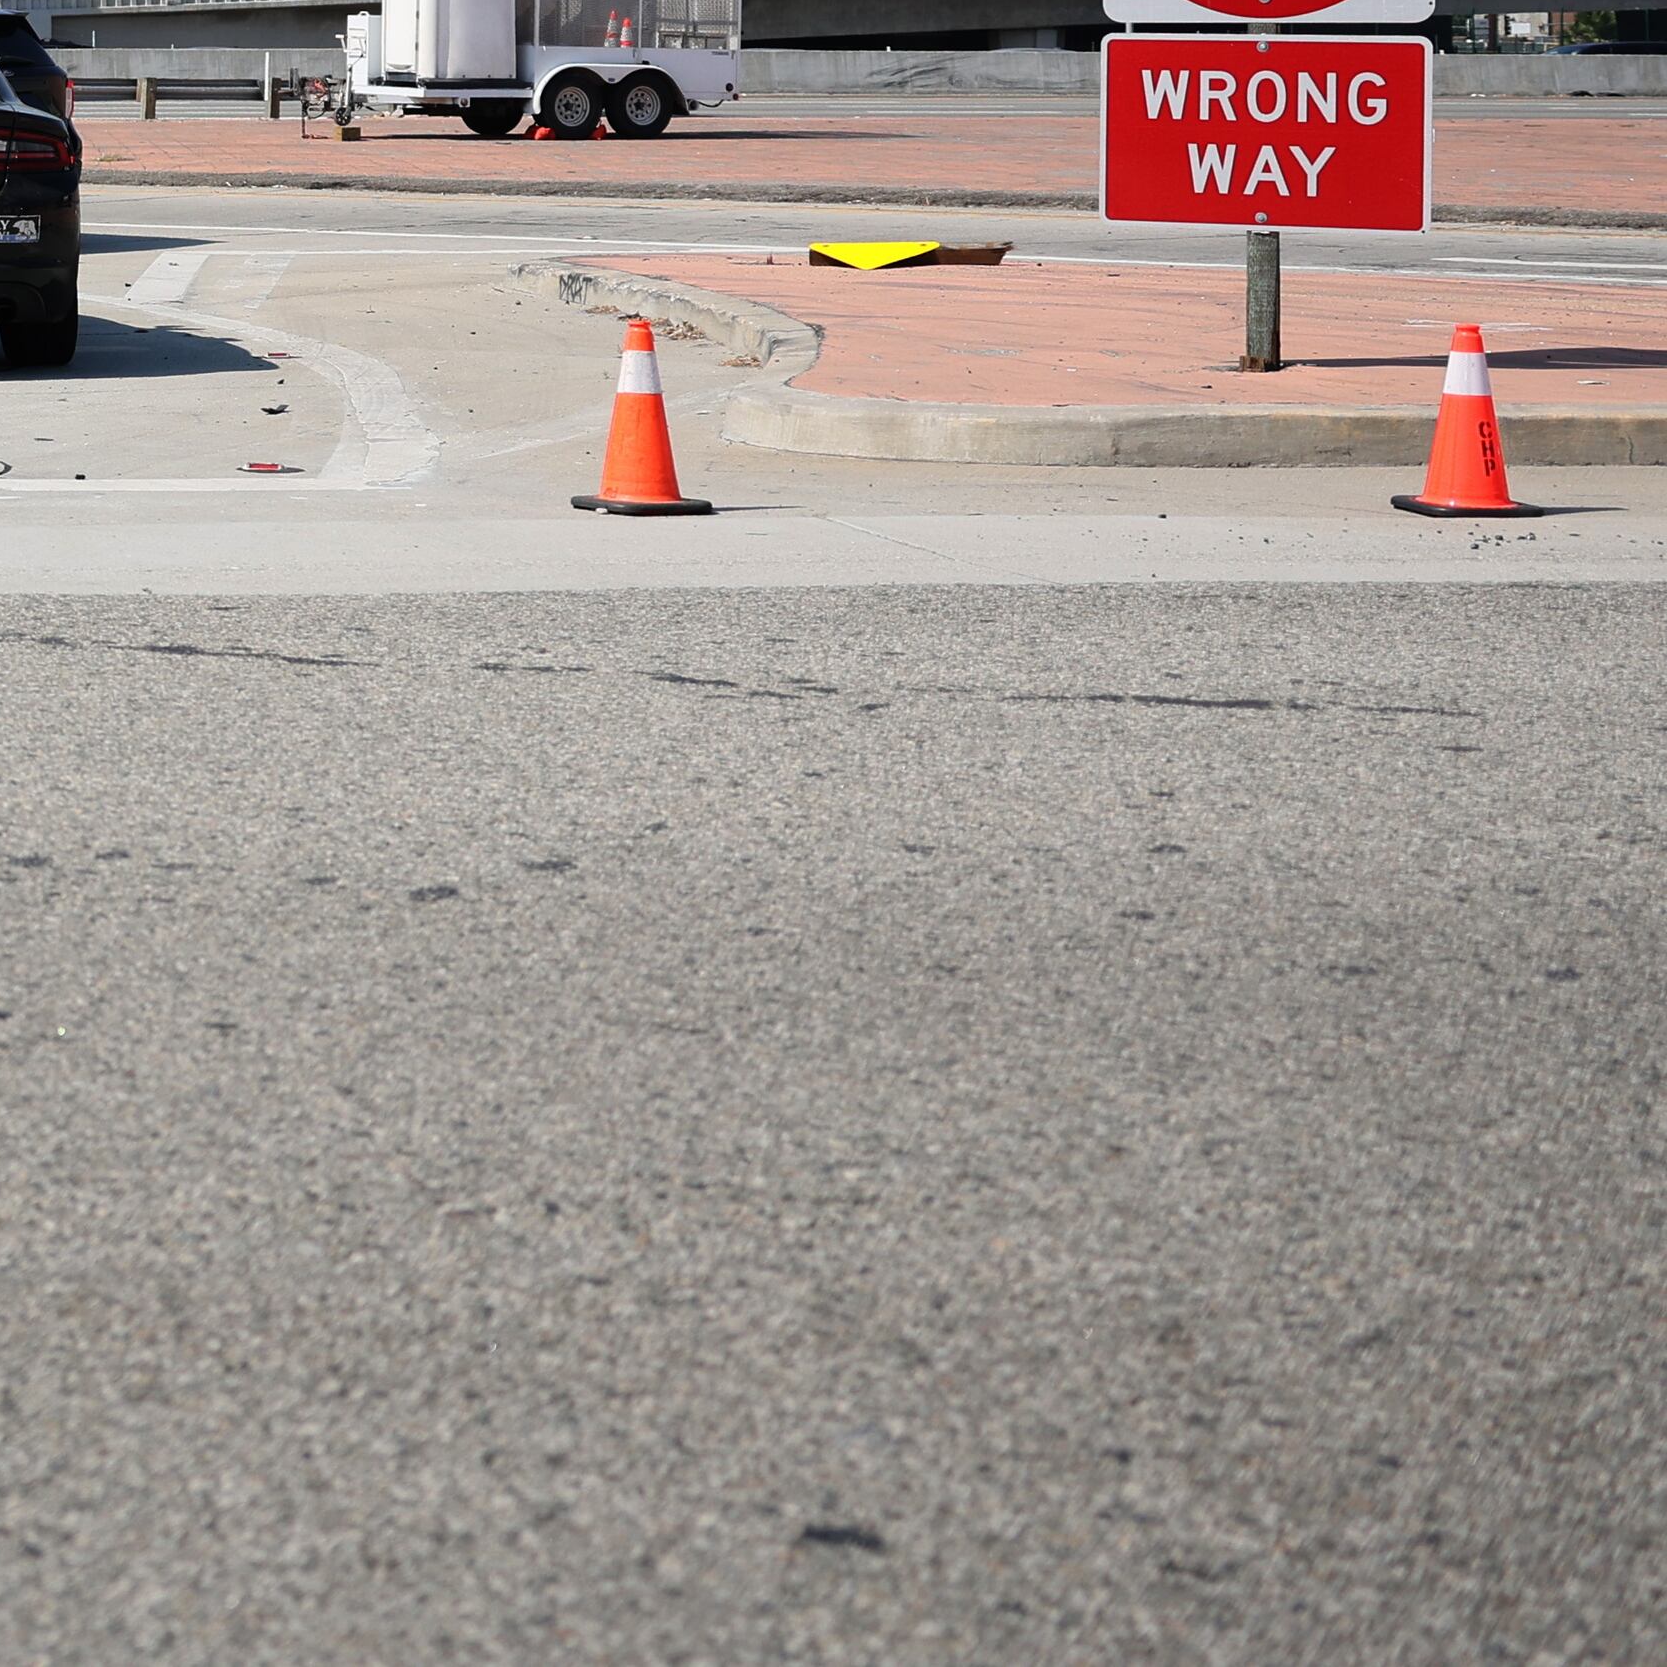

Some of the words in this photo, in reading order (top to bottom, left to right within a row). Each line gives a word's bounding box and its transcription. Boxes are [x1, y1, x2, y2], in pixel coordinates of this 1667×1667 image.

[1141, 69, 1387, 125] WRONG
[1187, 143, 1336, 197] WAY
[1478, 421, 1496, 477] CHP
